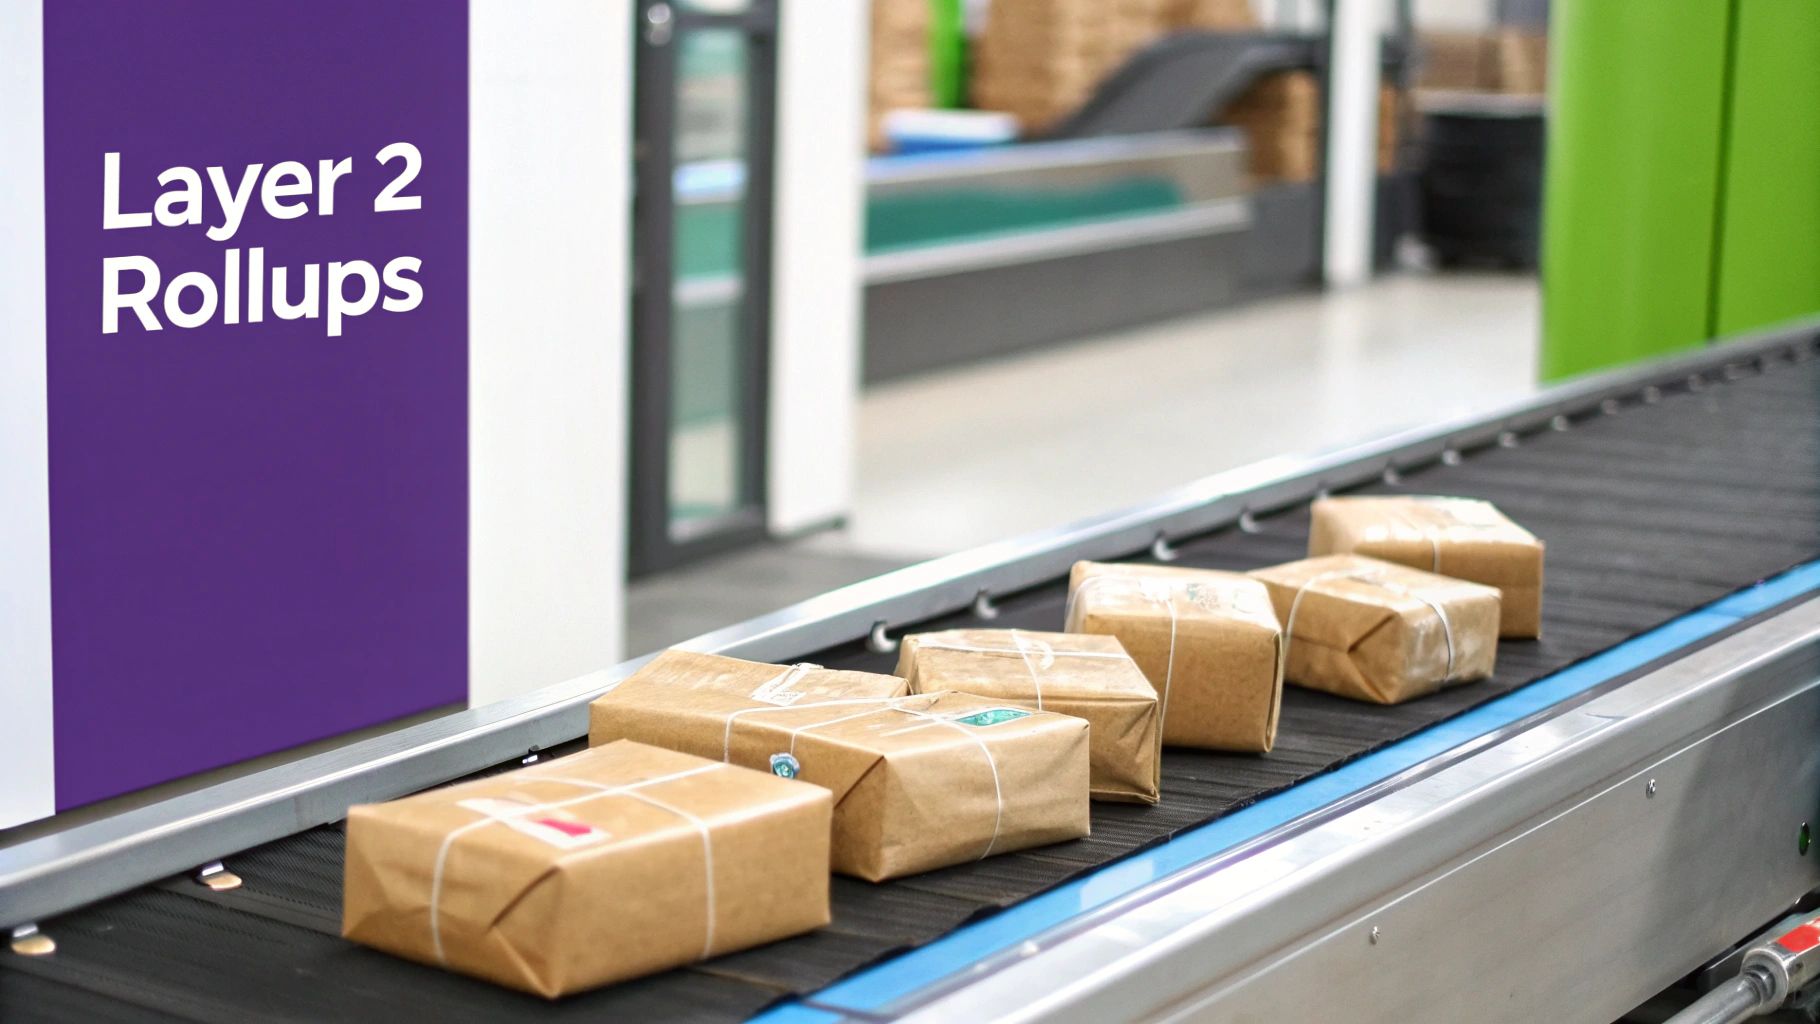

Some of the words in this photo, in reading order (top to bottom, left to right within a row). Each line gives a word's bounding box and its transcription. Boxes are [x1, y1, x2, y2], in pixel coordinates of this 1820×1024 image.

[103, 152, 353, 242] Layer
[374, 142, 423, 213] 2
[102, 246, 424, 337] Rollups
